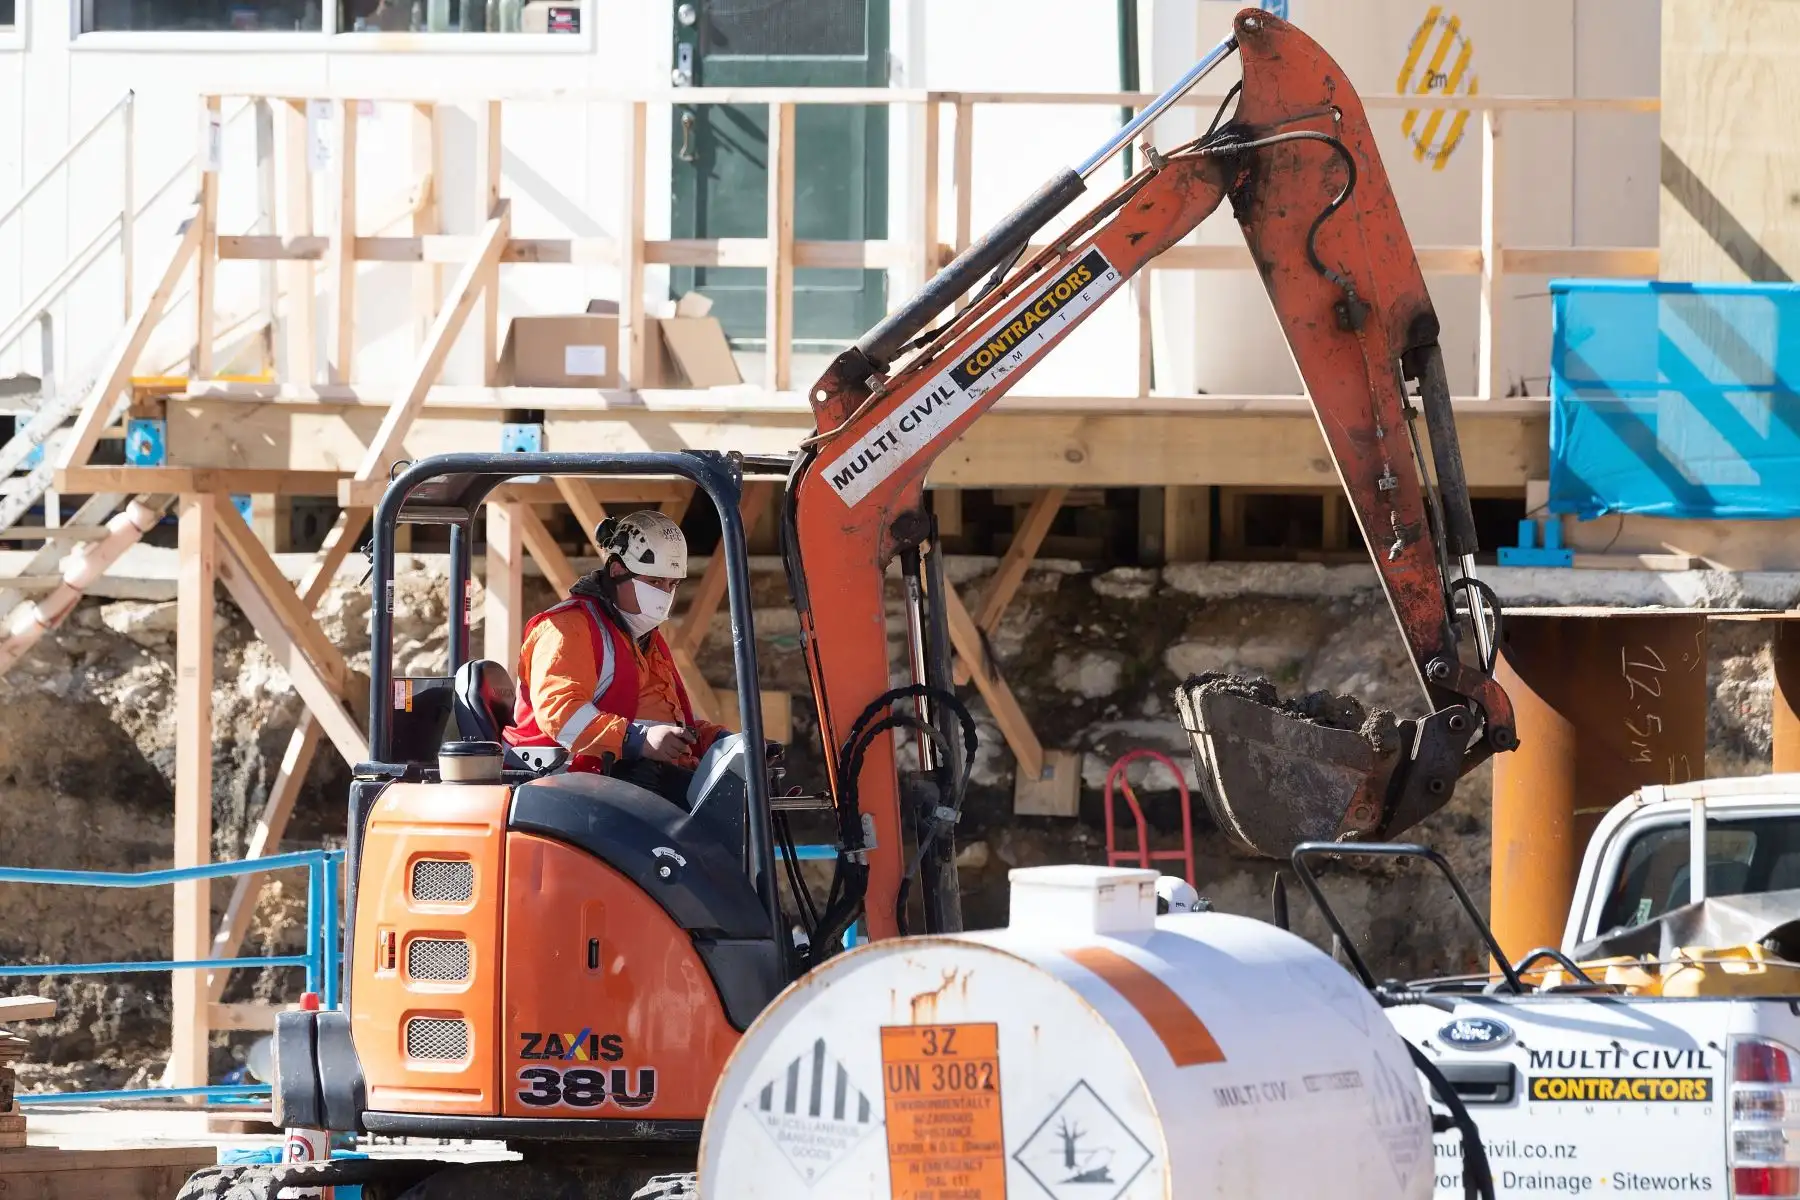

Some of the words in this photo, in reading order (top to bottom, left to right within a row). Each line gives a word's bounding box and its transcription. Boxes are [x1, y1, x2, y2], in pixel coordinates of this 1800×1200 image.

[1427, 68, 1448, 89] 2m
[832, 430, 898, 491] MULTI
[898, 385, 956, 433] CIVIL
[965, 264, 1092, 376] CONTRACTORS
[519, 1027, 624, 1062] ZAXIS
[921, 1027, 957, 1056] 3Z
[1530, 1050, 1621, 1069] MULTI
[1632, 1050, 1713, 1069] CIVIL
[517, 1066, 656, 1109] 38U
[888, 1063, 920, 1093] UN
[931, 1062, 995, 1091] 3082
[1533, 1077, 1707, 1100] CONTRACTORS
[1261, 1080, 1292, 1103] CIV
[1503, 1170, 1593, 1195] Drainage
[1612, 1171, 1712, 1191] Siteworks
